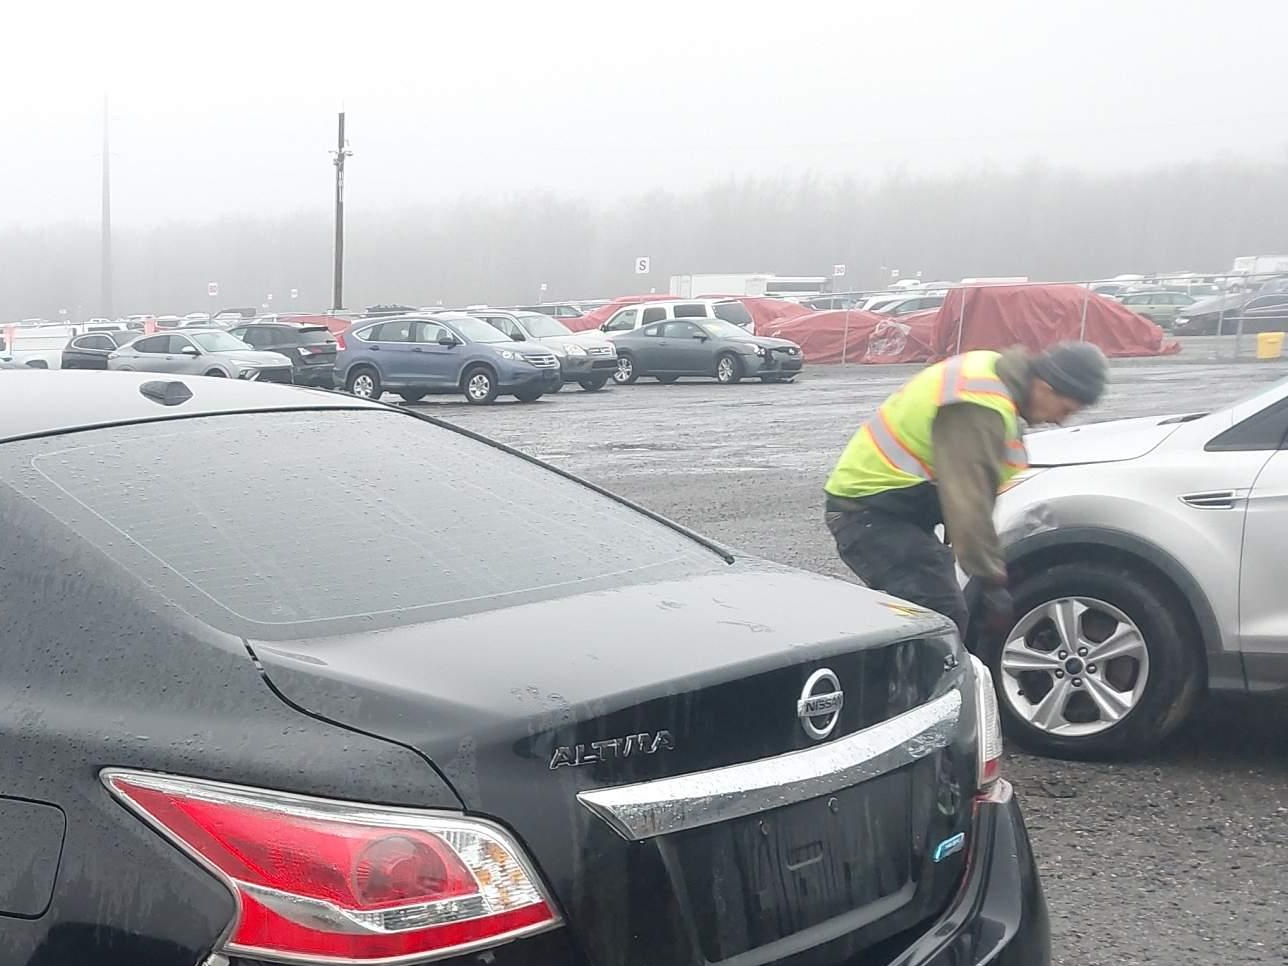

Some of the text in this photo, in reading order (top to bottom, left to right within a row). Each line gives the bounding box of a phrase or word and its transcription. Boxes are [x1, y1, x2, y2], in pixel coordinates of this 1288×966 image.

[639, 259, 647, 271] S
[805, 694, 842, 713] NISSAN
[549, 729, 674, 770] ALTIMA
